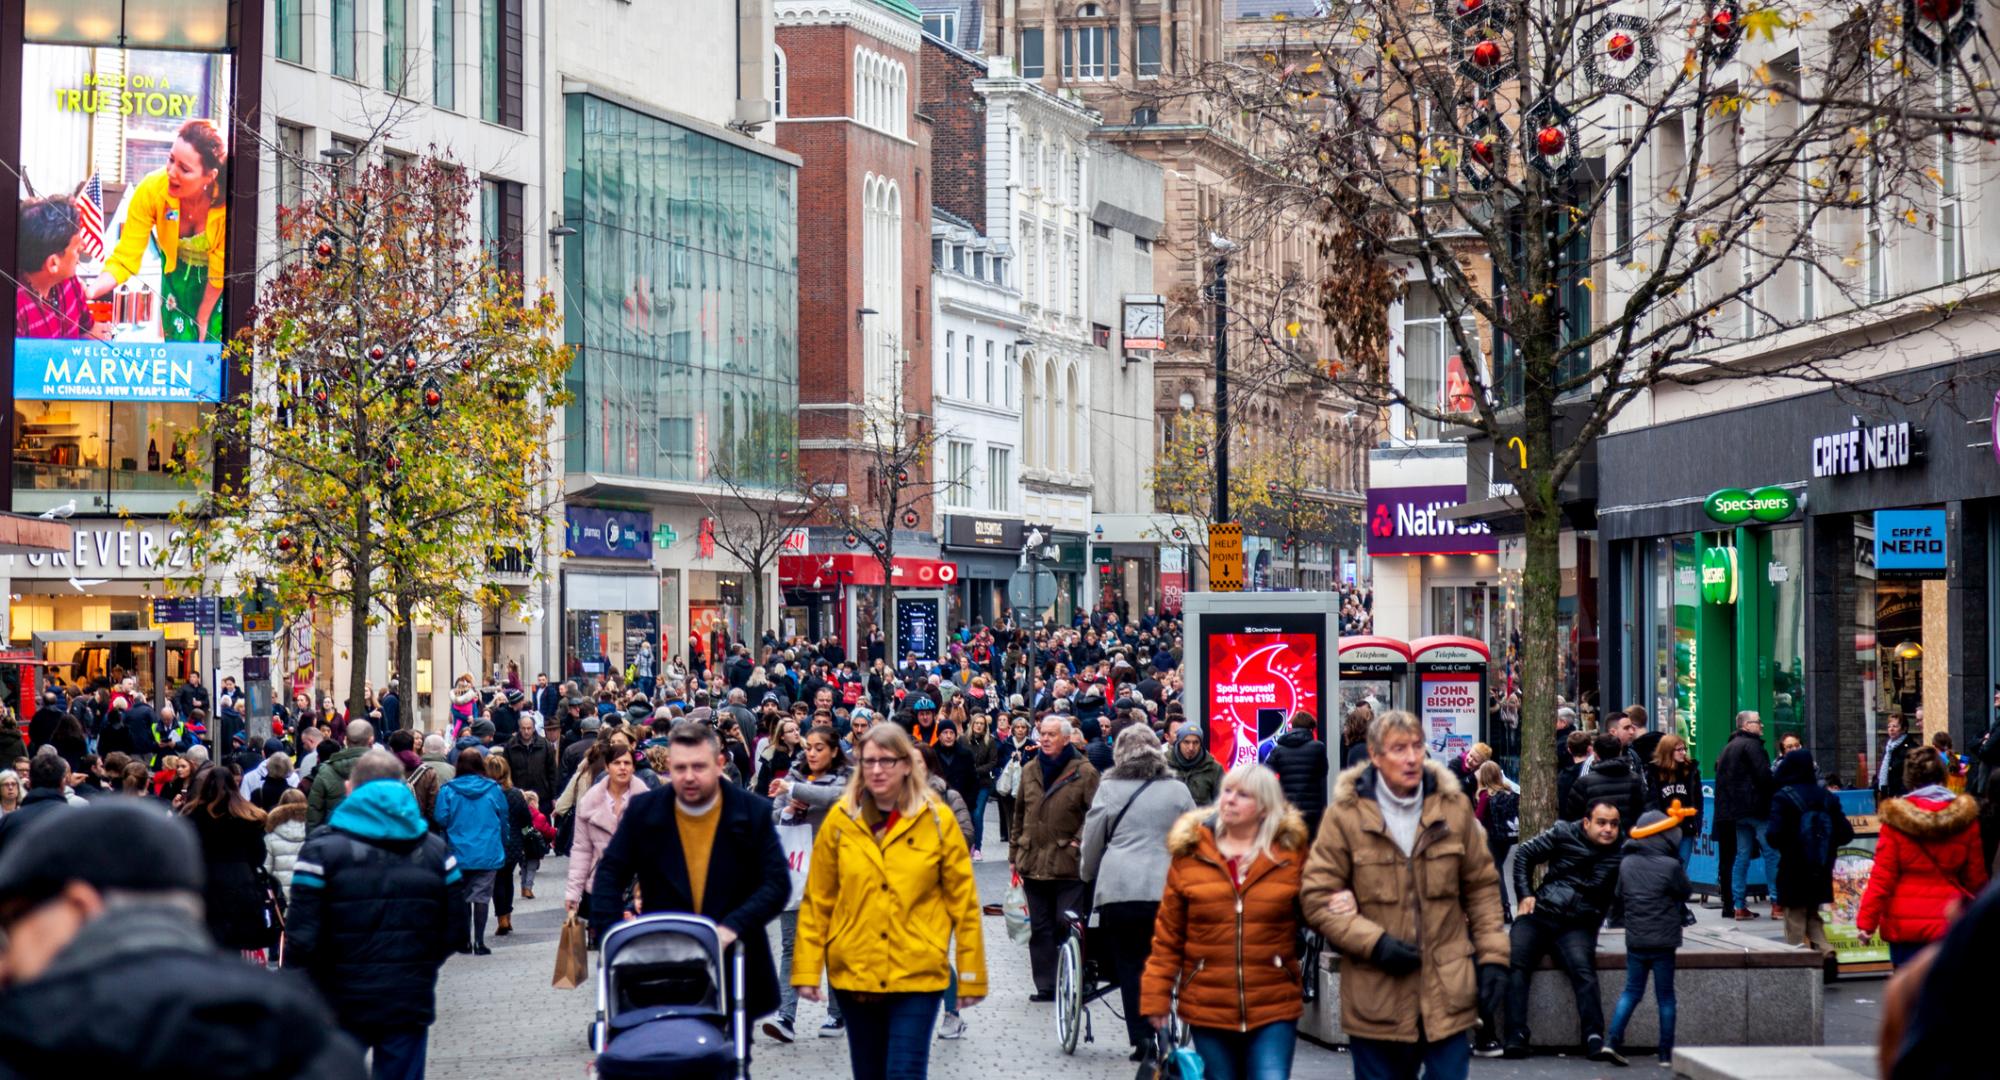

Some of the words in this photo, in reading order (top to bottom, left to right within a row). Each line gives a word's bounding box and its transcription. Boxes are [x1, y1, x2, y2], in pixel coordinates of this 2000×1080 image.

[83, 72, 128, 88] BASED
[132, 75, 154, 88] ON
[160, 76, 170, 89] A
[55, 88, 113, 113] TRUE
[119, 91, 198, 117] STORY
[71, 346, 141, 358] WELCOME
[150, 348, 167, 358] TO
[43, 357, 192, 385] MARWEN
[43, 385, 54, 394] IN
[58, 385, 102, 395] CINEMAS
[105, 386, 129, 395] NEW
[132, 386, 167, 396] YEAR'S
[170, 387, 191, 397] DAY
[1864, 422, 1909, 470] NERO
[1715, 498, 1788, 514] Specsavers
[583, 525, 601, 540] pharmacy
[1215, 540, 1238, 548] HELP
[1881, 539, 1944, 554] NERO
[1213, 553, 1239, 562] POINT
[1355, 651, 1389, 659] Telephone
[1435, 650, 1468, 658] Telephone
[1216, 683, 1238, 695] Spoil
[1239, 683, 1275, 695] yourself
[1433, 686, 1468, 696] JOHN
[1216, 693, 1233, 703] and
[1234, 695, 1254, 703] save
[1255, 693, 1276, 703] £192
[1426, 697, 1475, 707] BISHOP
[1239, 745, 1257, 759] BIG
